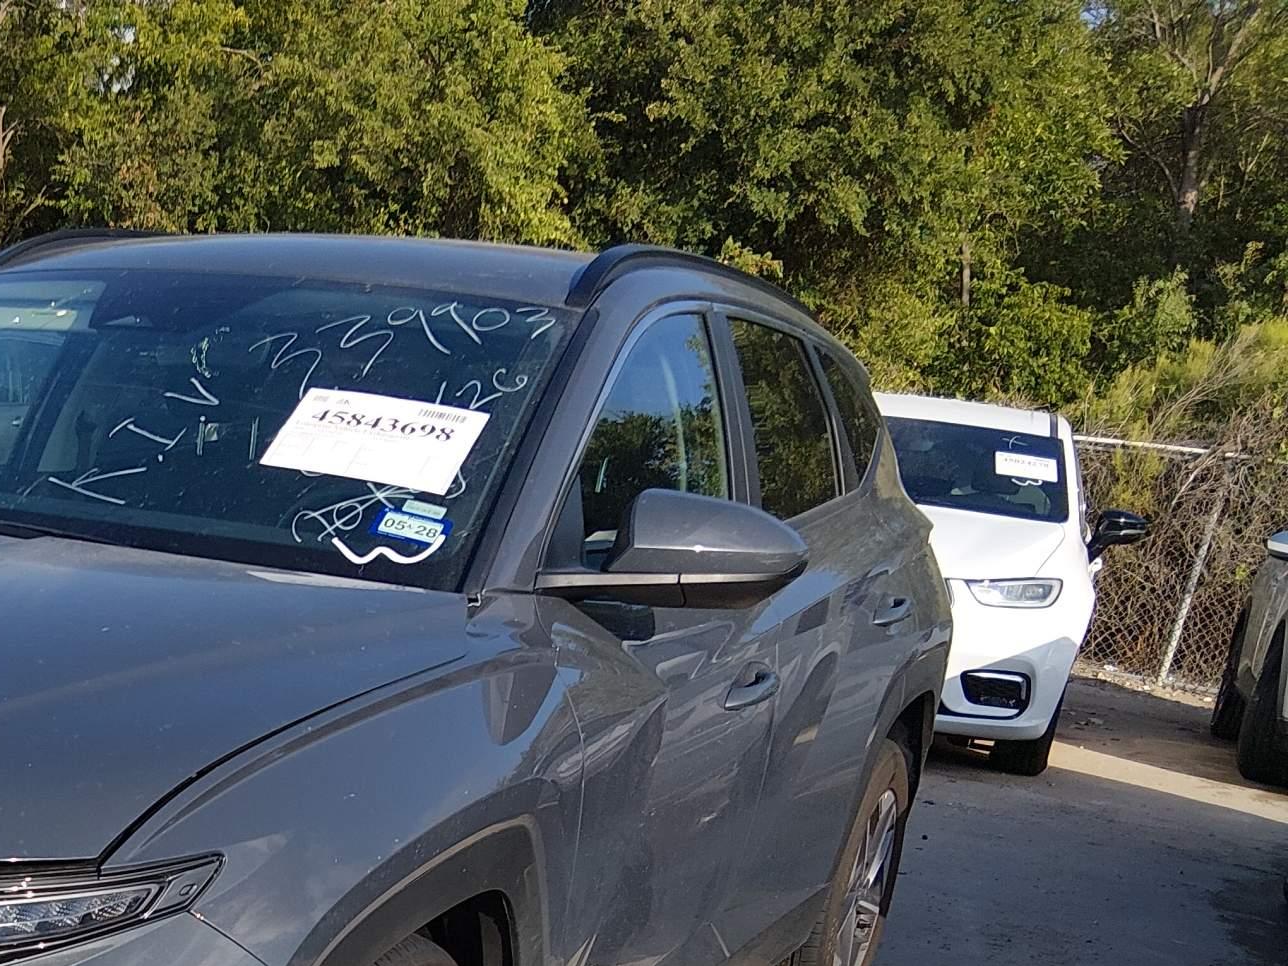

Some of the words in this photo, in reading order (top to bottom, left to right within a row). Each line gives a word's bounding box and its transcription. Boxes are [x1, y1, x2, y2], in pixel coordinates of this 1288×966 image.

[311, 408, 456, 442] 45843698
[383, 518, 408, 531] 05
[414, 524, 438, 539] 28
